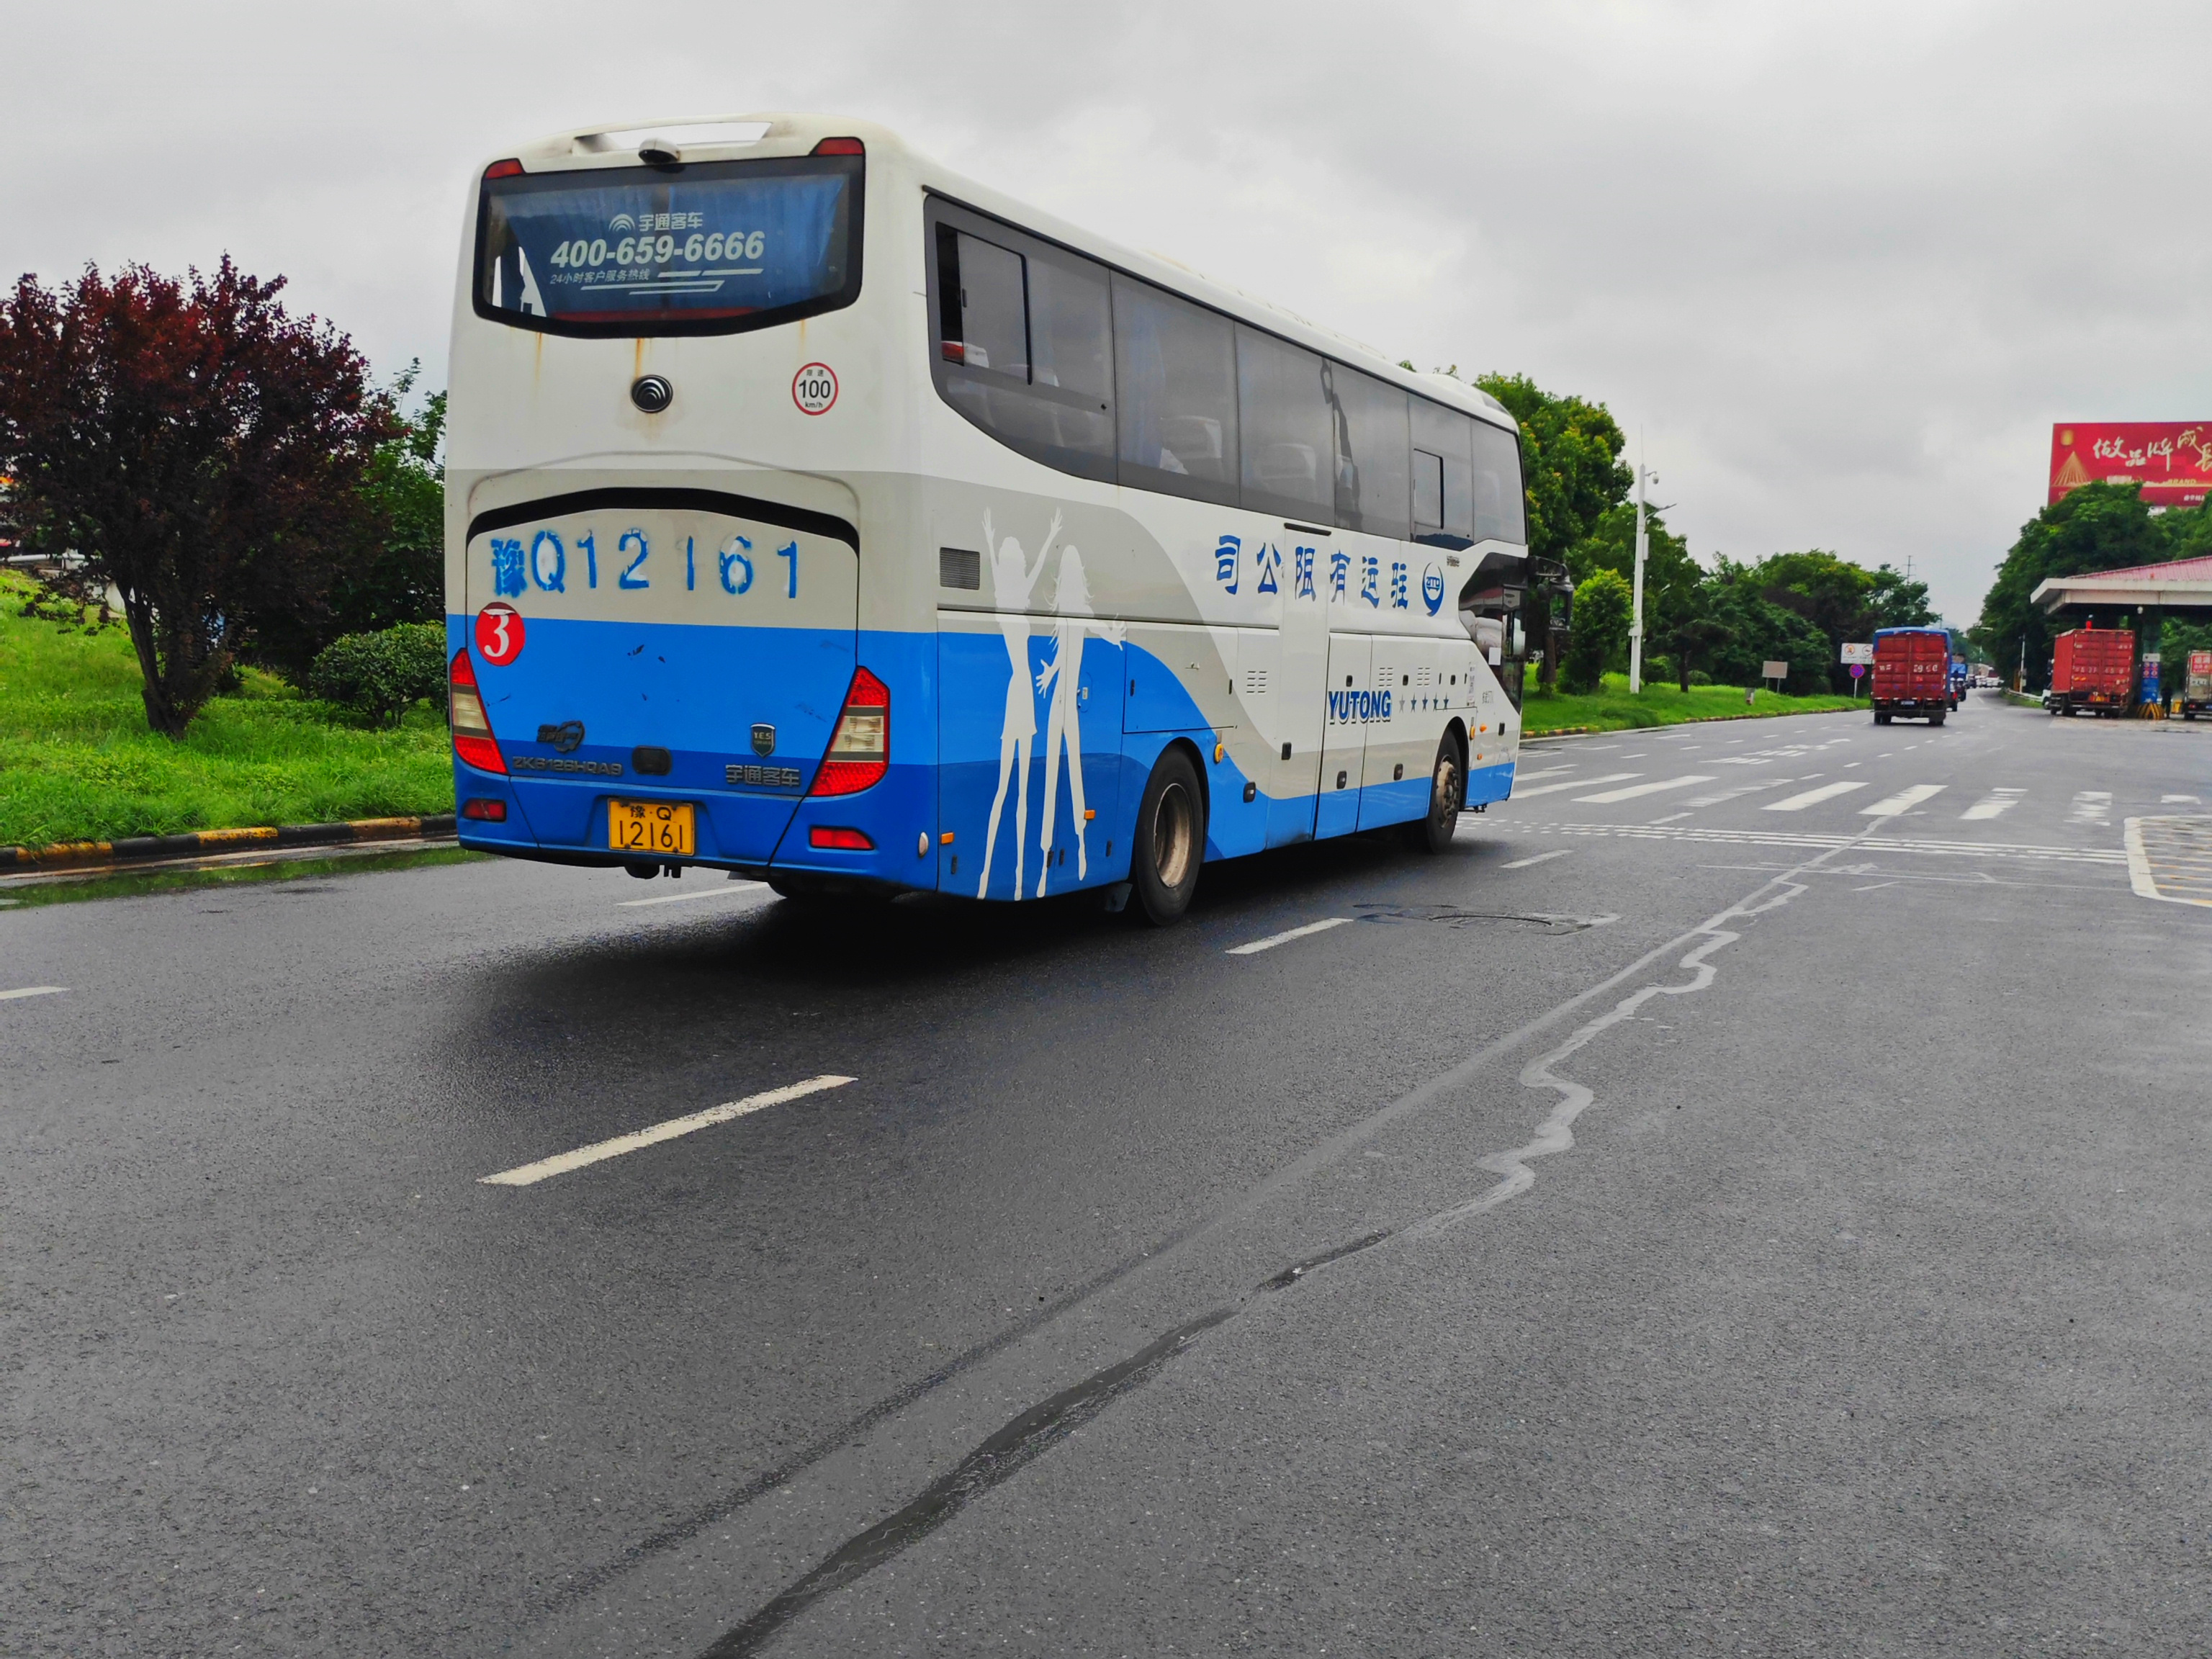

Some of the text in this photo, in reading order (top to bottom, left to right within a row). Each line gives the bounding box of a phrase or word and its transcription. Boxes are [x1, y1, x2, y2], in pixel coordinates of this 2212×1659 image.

[639, 212, 703, 232] 宇通客车
[550, 230, 765, 268] 400-659-6666
[549, 269, 651, 284] 24小时客户服务热线
[799, 379, 831, 399] 100
[483, 612, 510, 658] 3
[1328, 690, 1391, 725] YUTONG
[725, 764, 800, 787] 宇通客车
[619, 819, 683, 850] 12161
